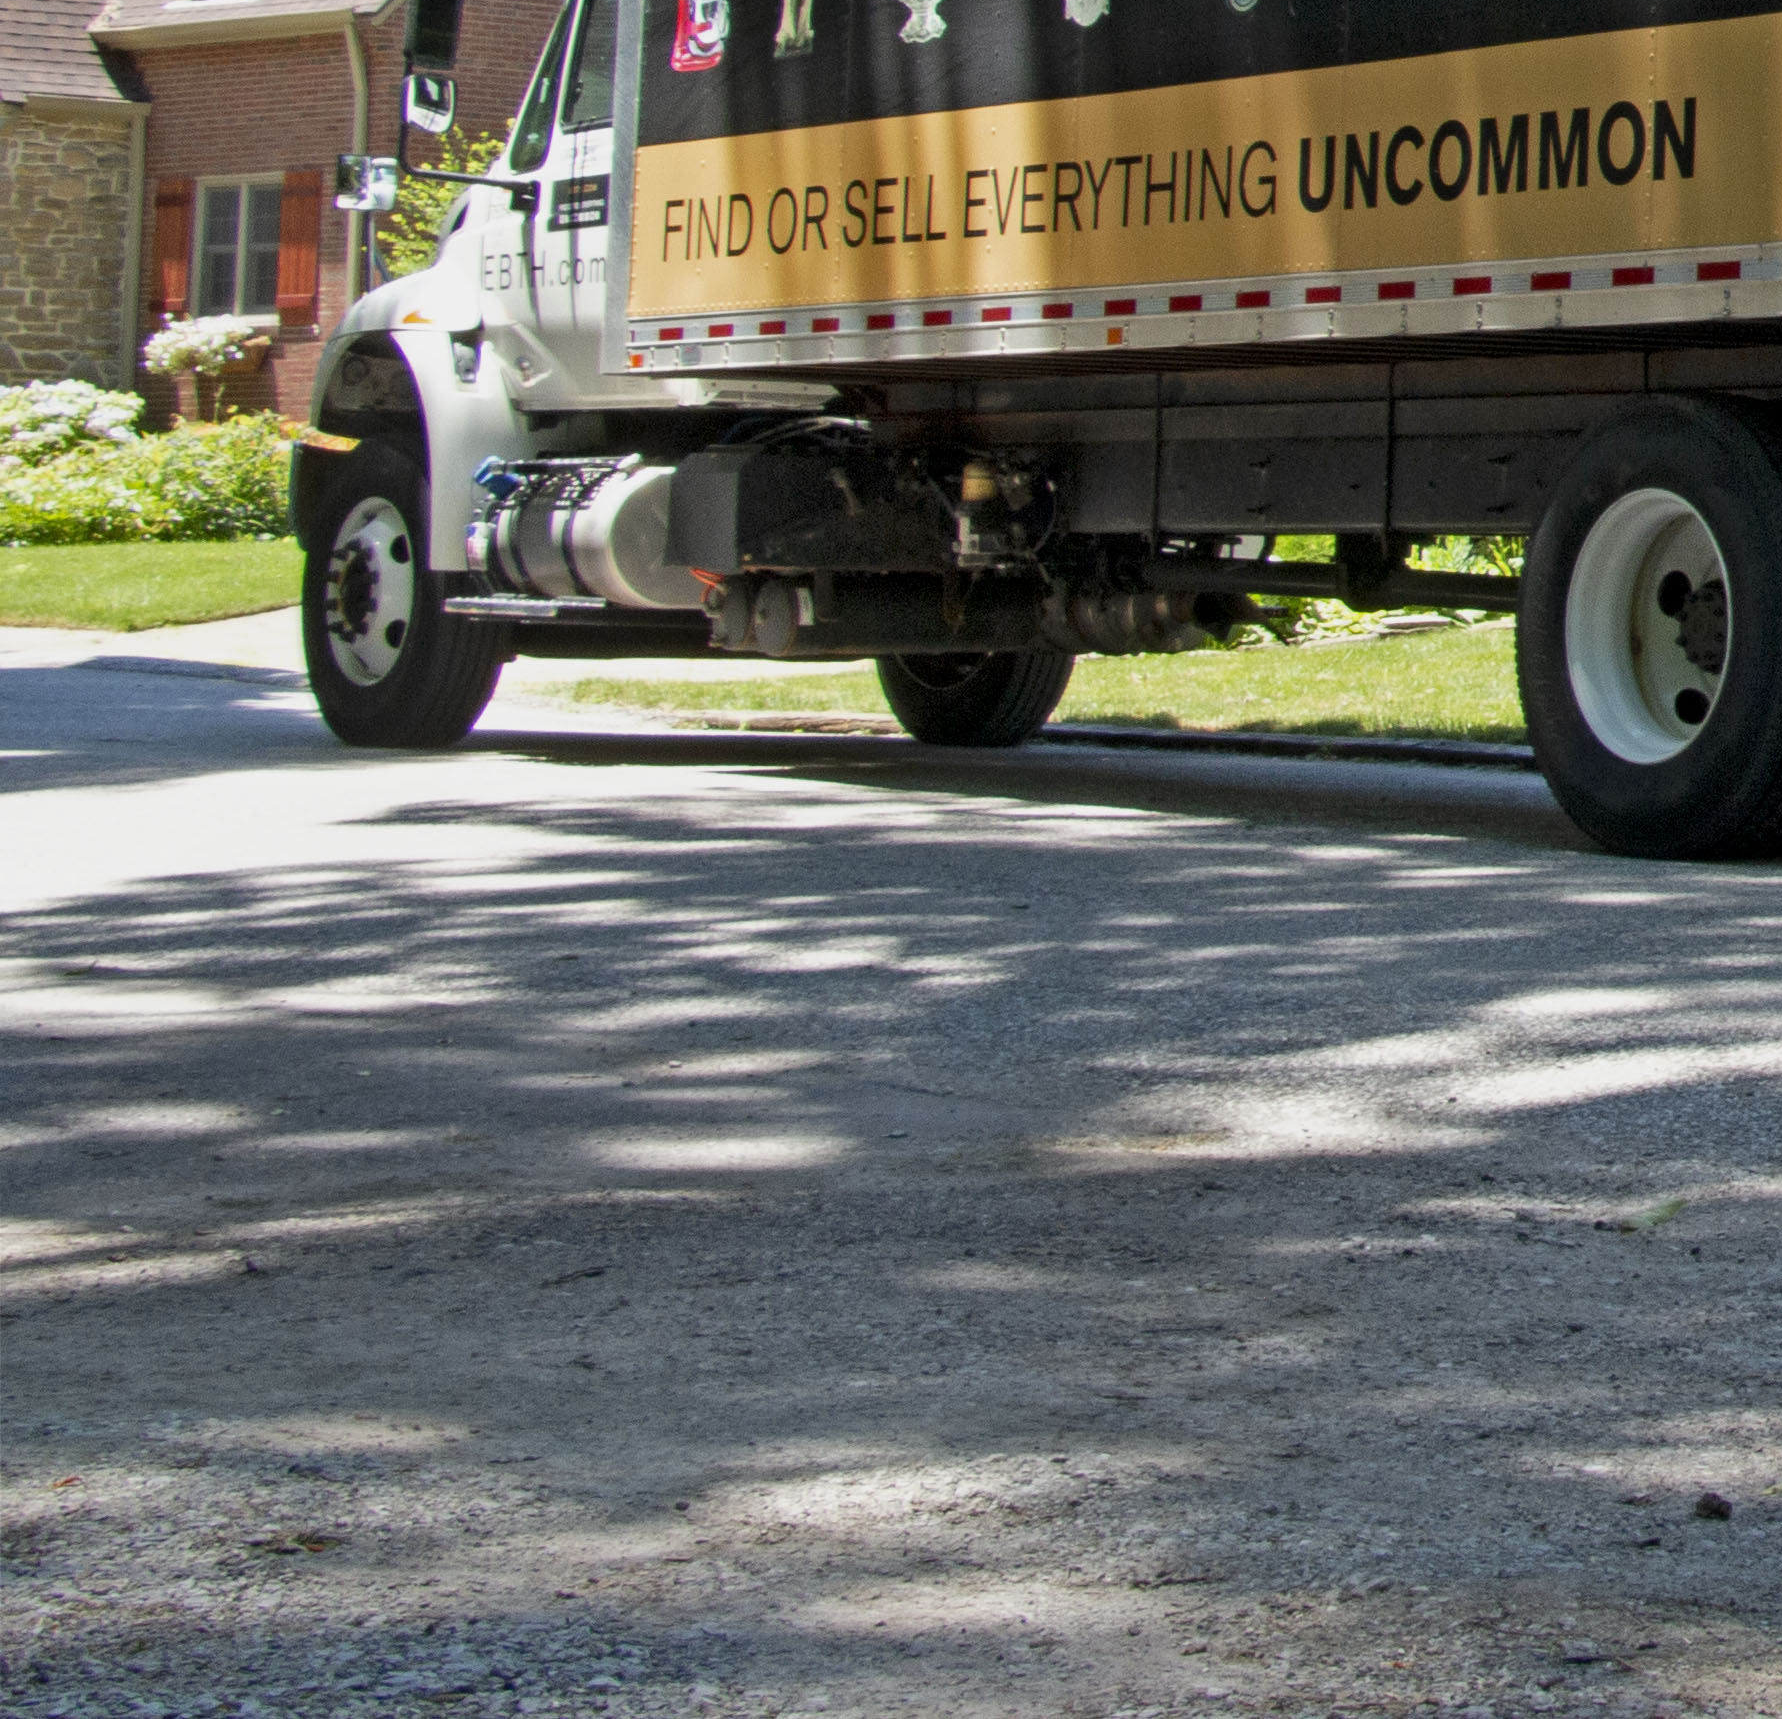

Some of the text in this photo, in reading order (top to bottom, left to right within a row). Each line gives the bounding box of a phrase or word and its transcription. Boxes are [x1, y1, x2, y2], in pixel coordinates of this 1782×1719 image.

[662, 97, 1697, 262] FIND OR SELL EVERYTHING UNCOMMON
[484, 250, 607, 291] EBTH.com
